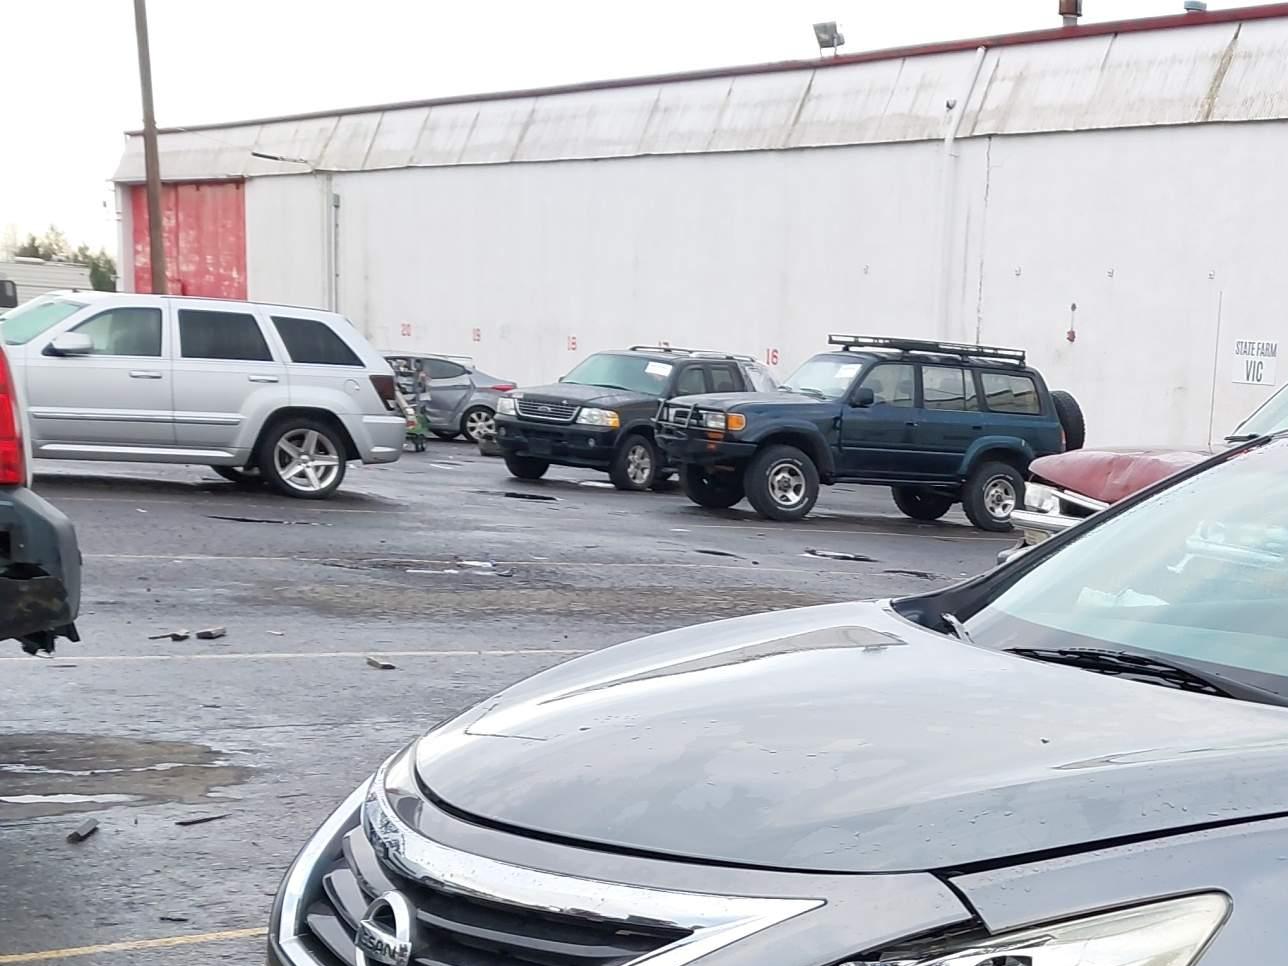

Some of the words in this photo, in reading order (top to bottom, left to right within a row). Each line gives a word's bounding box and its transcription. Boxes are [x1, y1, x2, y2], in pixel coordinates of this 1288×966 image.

[766, 348, 779, 366] 16
[1235, 341, 1256, 356] STATE
[1256, 342, 1278, 357] FARM
[1245, 360, 1264, 382] VIC
